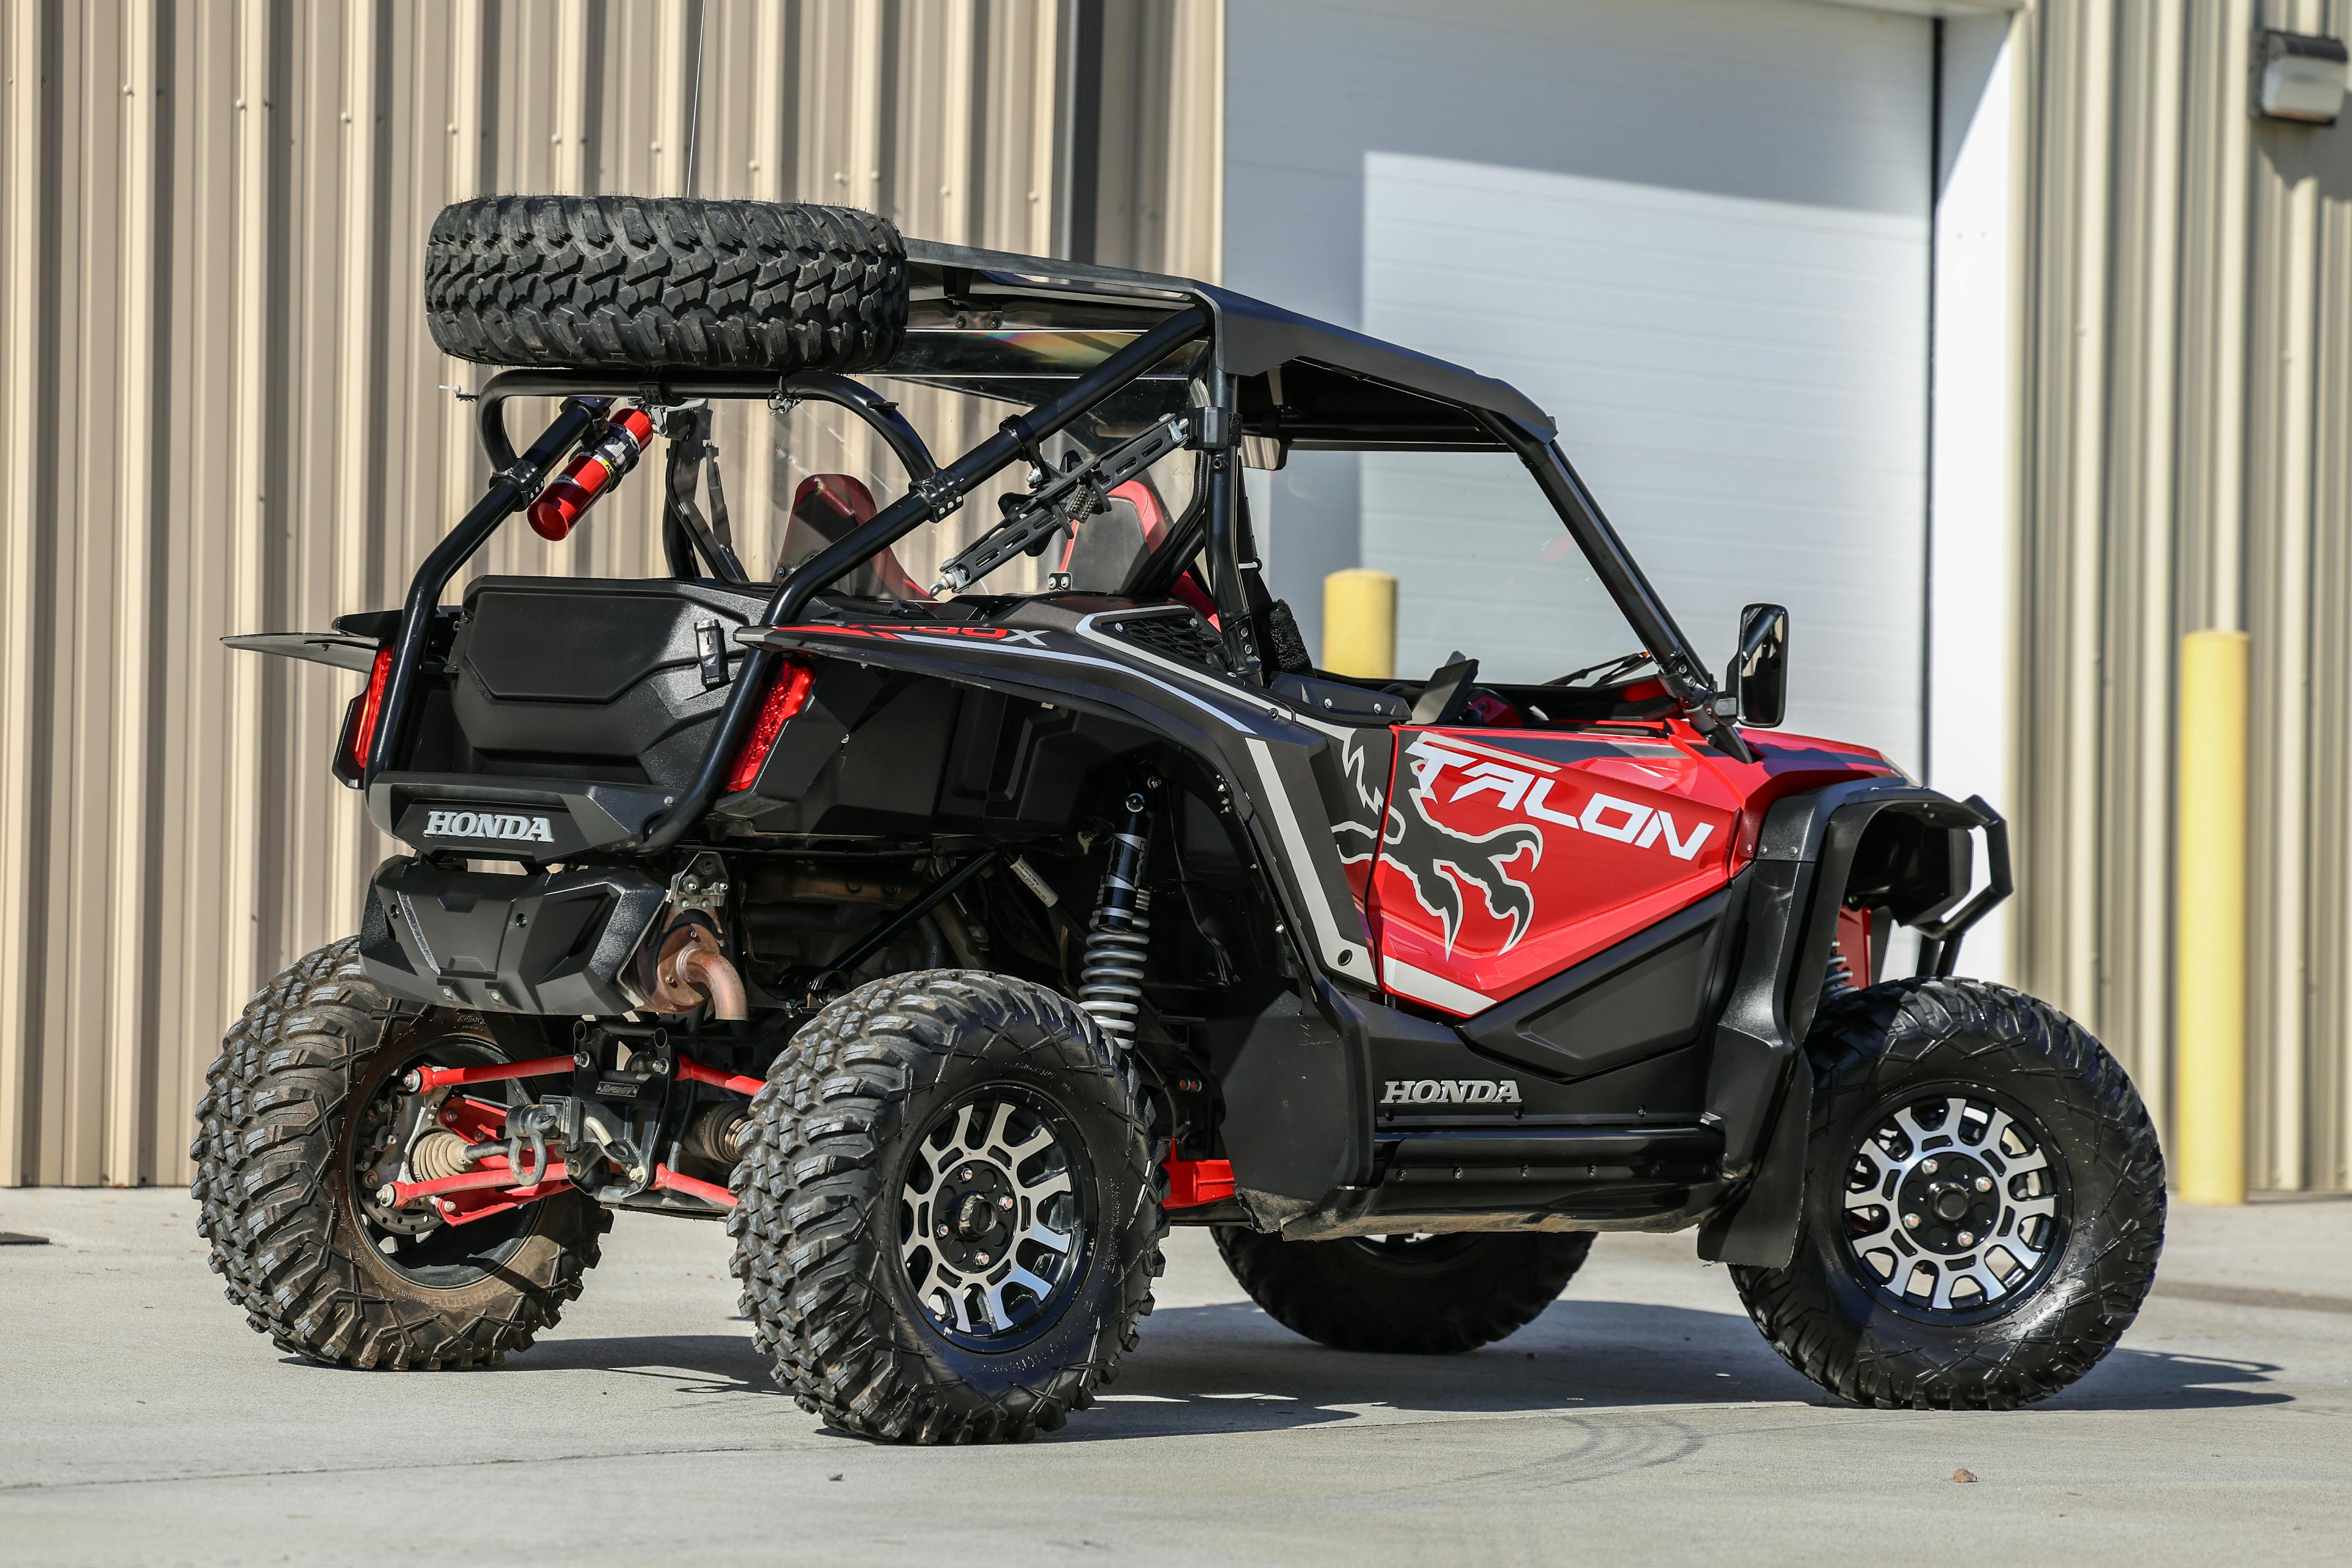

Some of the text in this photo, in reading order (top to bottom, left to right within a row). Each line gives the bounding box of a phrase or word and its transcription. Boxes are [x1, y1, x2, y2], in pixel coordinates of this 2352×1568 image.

[1405, 741, 1714, 861] TALON
[423, 810, 554, 843] HONDA
[1380, 1079, 1523, 1104] HONDA
